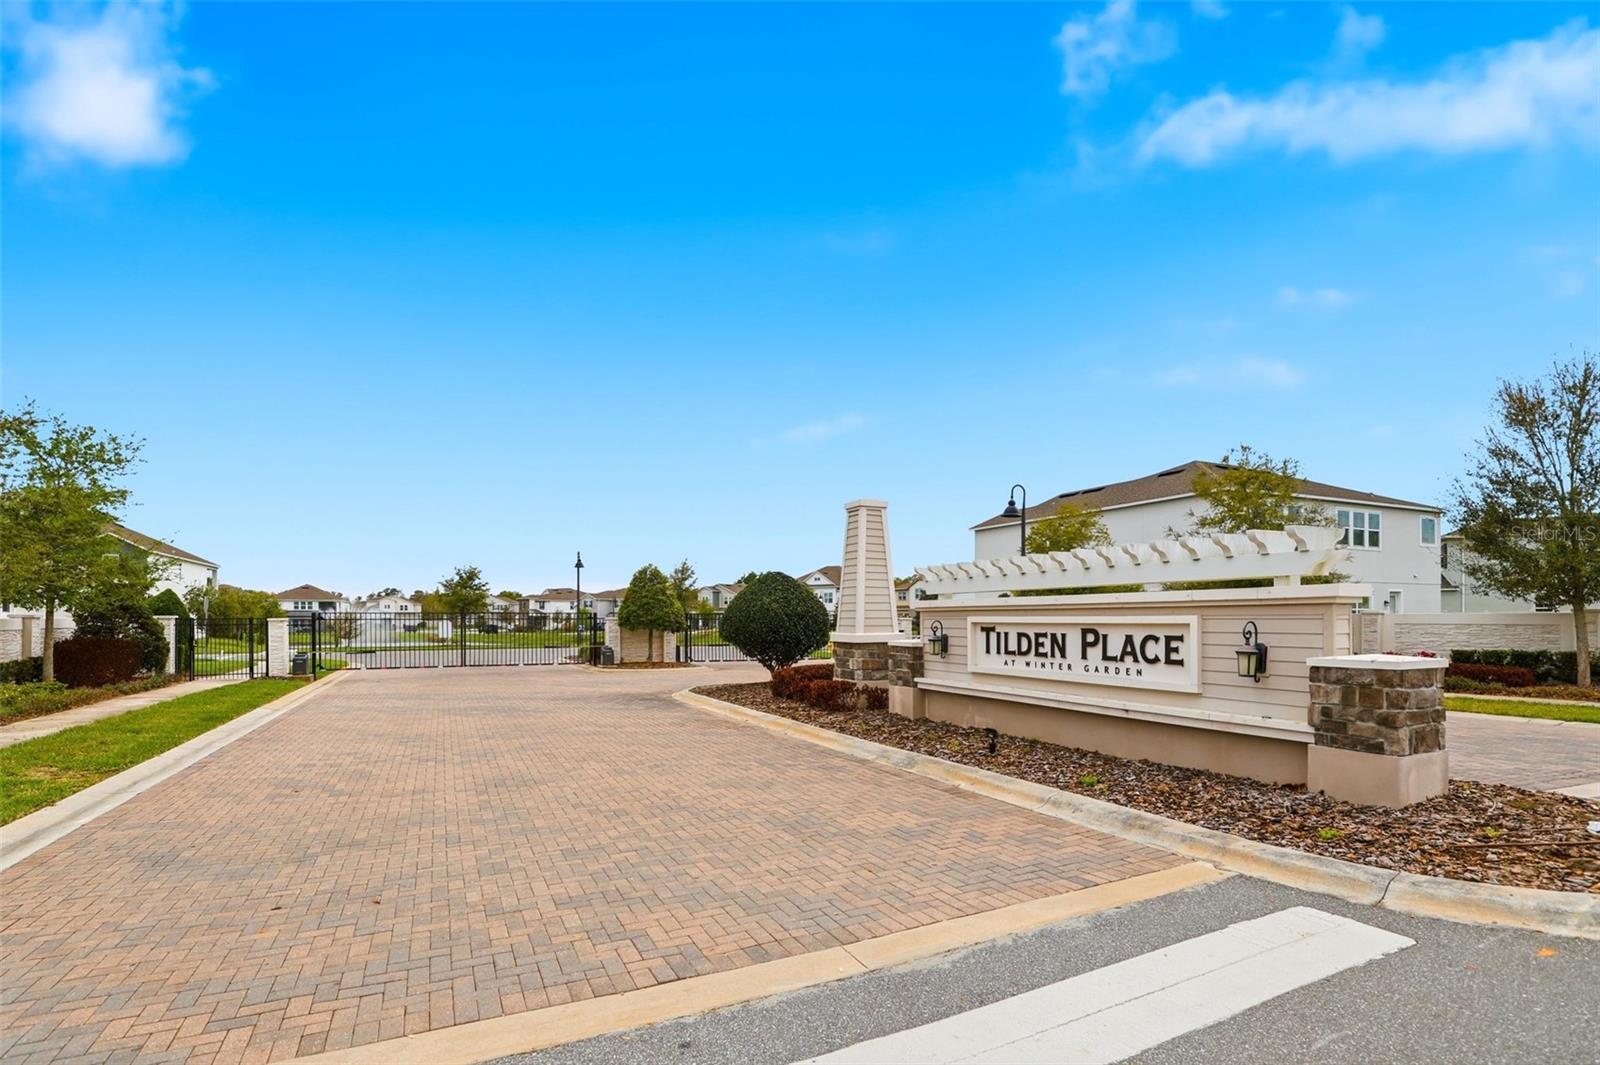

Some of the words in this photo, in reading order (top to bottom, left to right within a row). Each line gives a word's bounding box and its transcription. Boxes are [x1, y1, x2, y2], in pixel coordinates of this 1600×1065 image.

[980, 625, 1067, 659] TILDEN
[1080, 627, 1185, 667] PLACE
[1003, 659, 1016, 667] AT
[1025, 660, 1073, 671] WINTER
[1083, 665, 1144, 676] GARDEN
